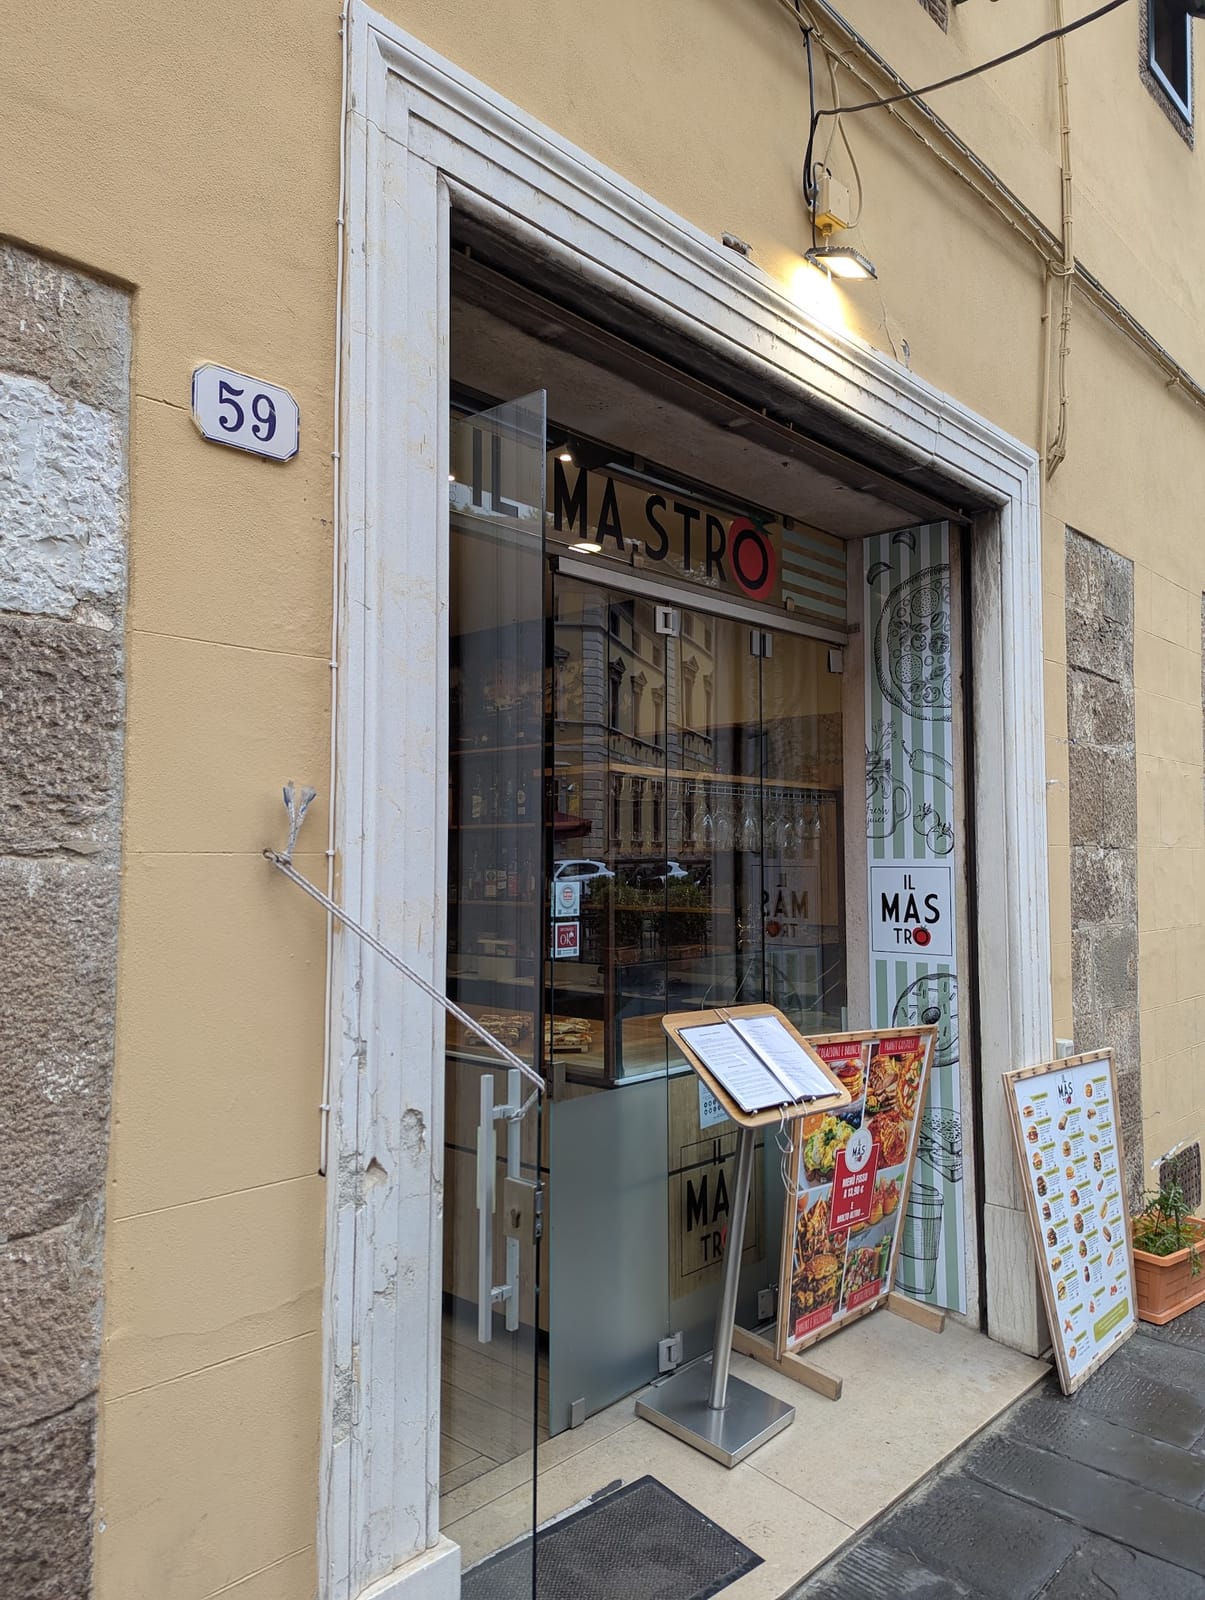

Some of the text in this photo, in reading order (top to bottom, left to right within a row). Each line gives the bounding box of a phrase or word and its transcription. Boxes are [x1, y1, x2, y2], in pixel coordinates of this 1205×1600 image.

[218, 380, 277, 442] 59
[472, 427, 519, 518] IL
[904, 874, 916, 890] IL
[881, 892, 941, 924] MAS
[893, 927, 931, 946] TRO
[713, 1138, 726, 1166] IL
[687, 1169, 730, 1232] MA
